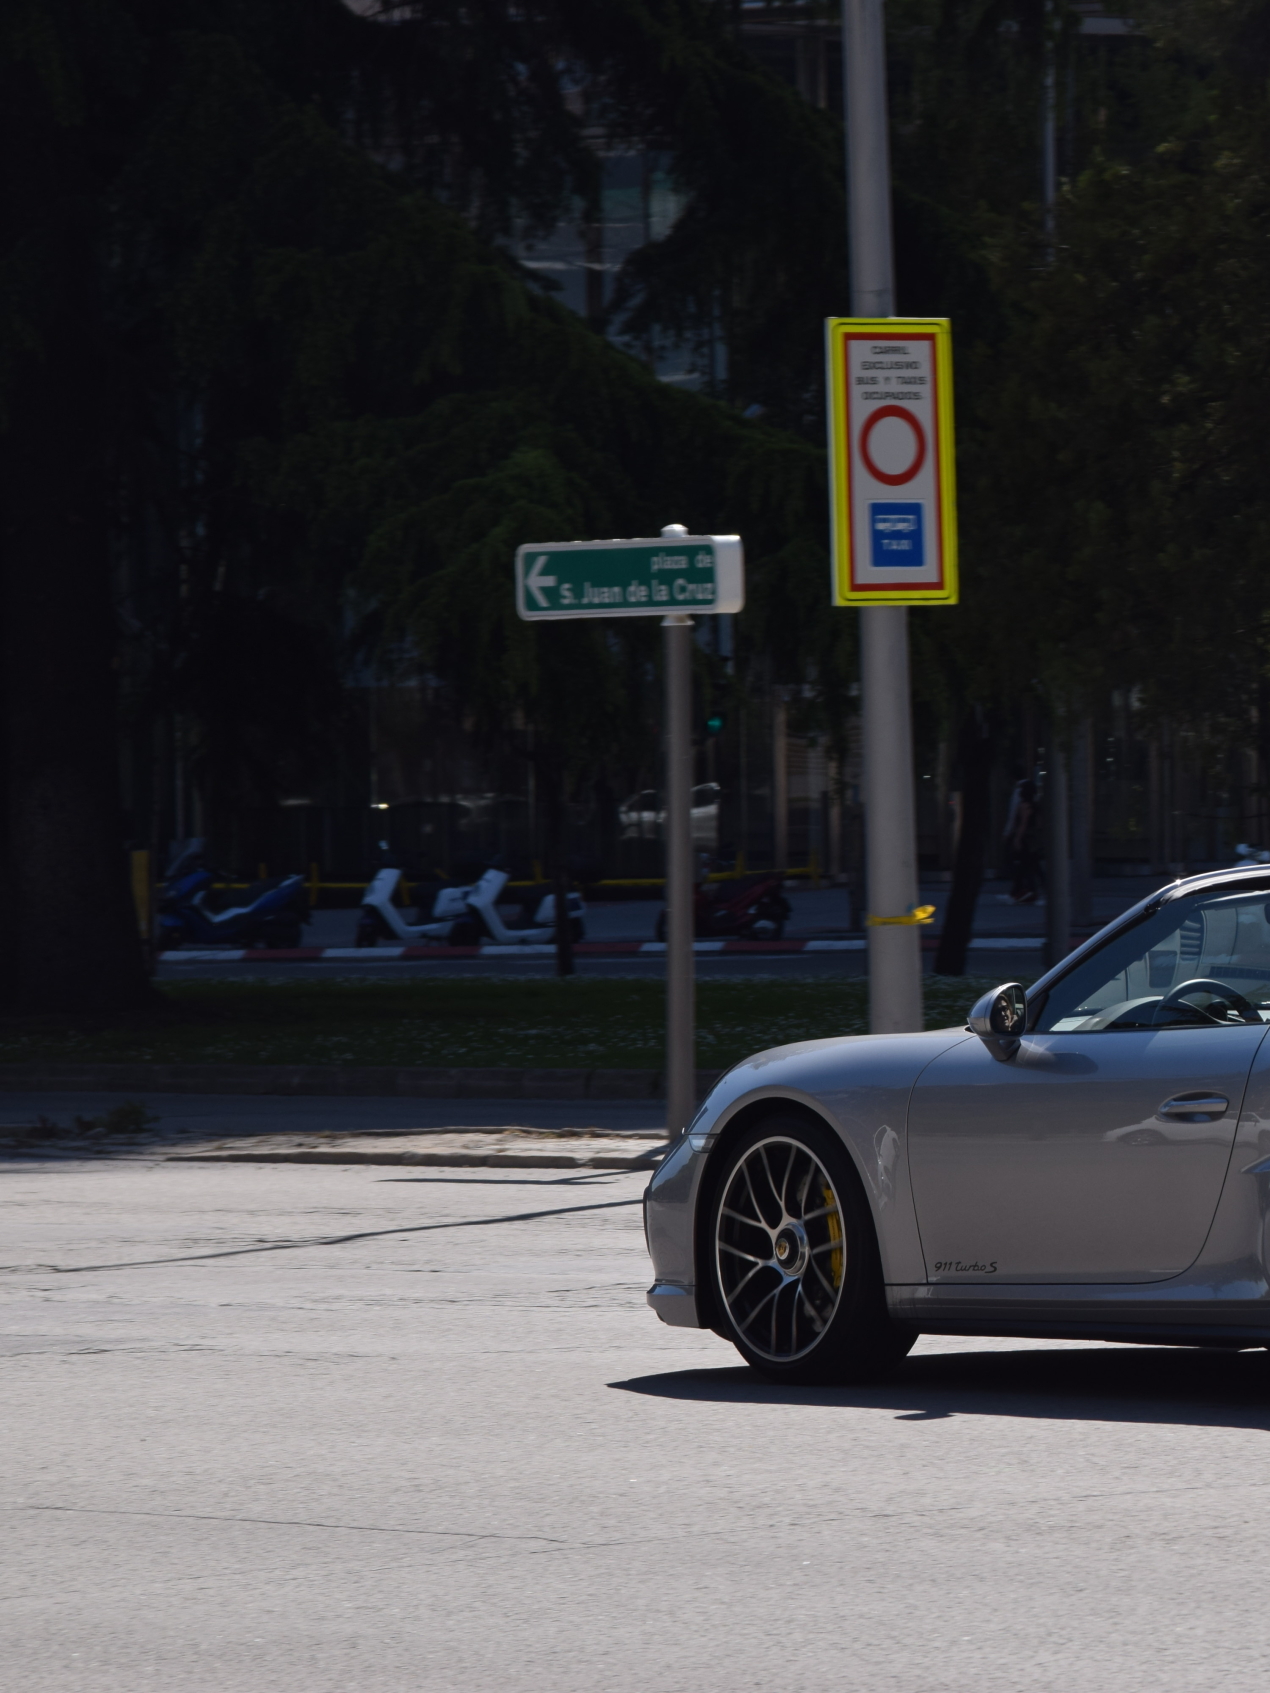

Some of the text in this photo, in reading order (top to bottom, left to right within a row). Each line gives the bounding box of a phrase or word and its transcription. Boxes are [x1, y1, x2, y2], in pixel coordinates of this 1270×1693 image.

[855, 376, 879, 385] BUS
[651, 551, 714, 572] plaza de
[559, 578, 714, 604] S. Juan de la Cruz
[934, 1261, 953, 1272] 911
[984, 1261, 998, 1274] S
